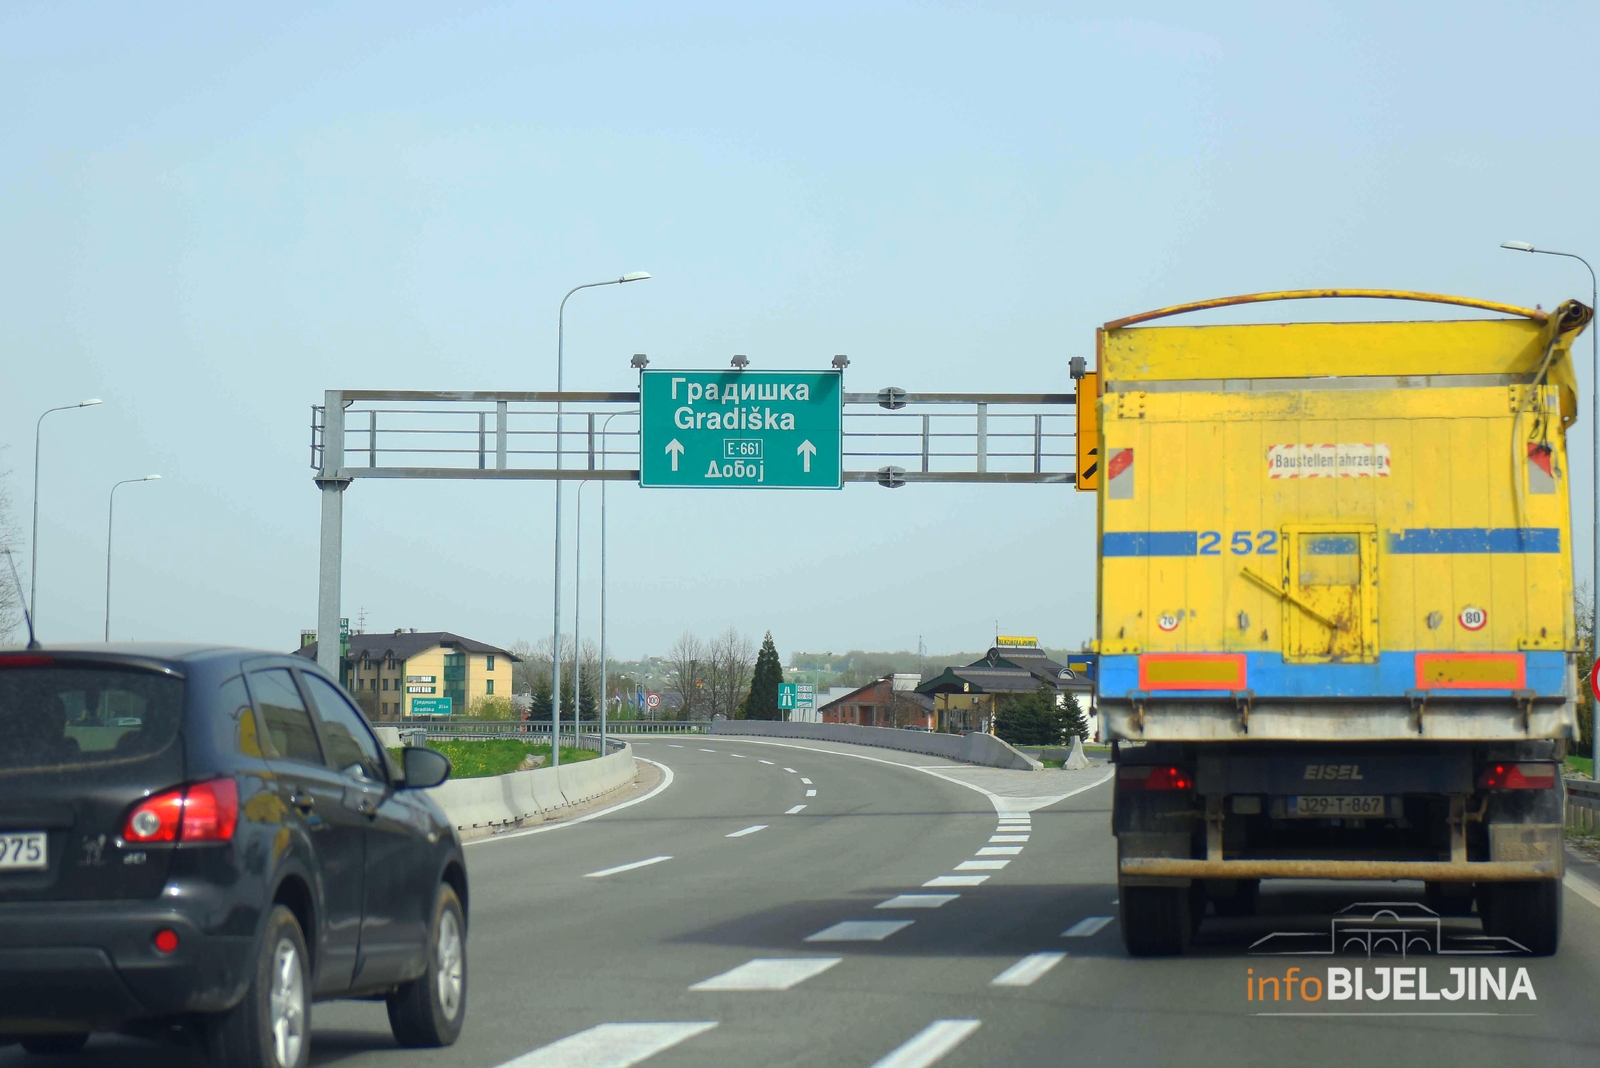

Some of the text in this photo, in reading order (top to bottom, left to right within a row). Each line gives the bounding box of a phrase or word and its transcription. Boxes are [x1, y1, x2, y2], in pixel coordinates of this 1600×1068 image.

[671, 377, 810, 405] Градишка
[674, 406, 796, 431] Gradiška
[727, 442, 760, 456] E-661
[704, 460, 764, 483] Добој
[1199, 529, 1278, 555] 252
[1465, 611, 1481, 624] 80
[1303, 764, 1364, 781] EISEL
[1299, 797, 1381, 813] J29-T-867
